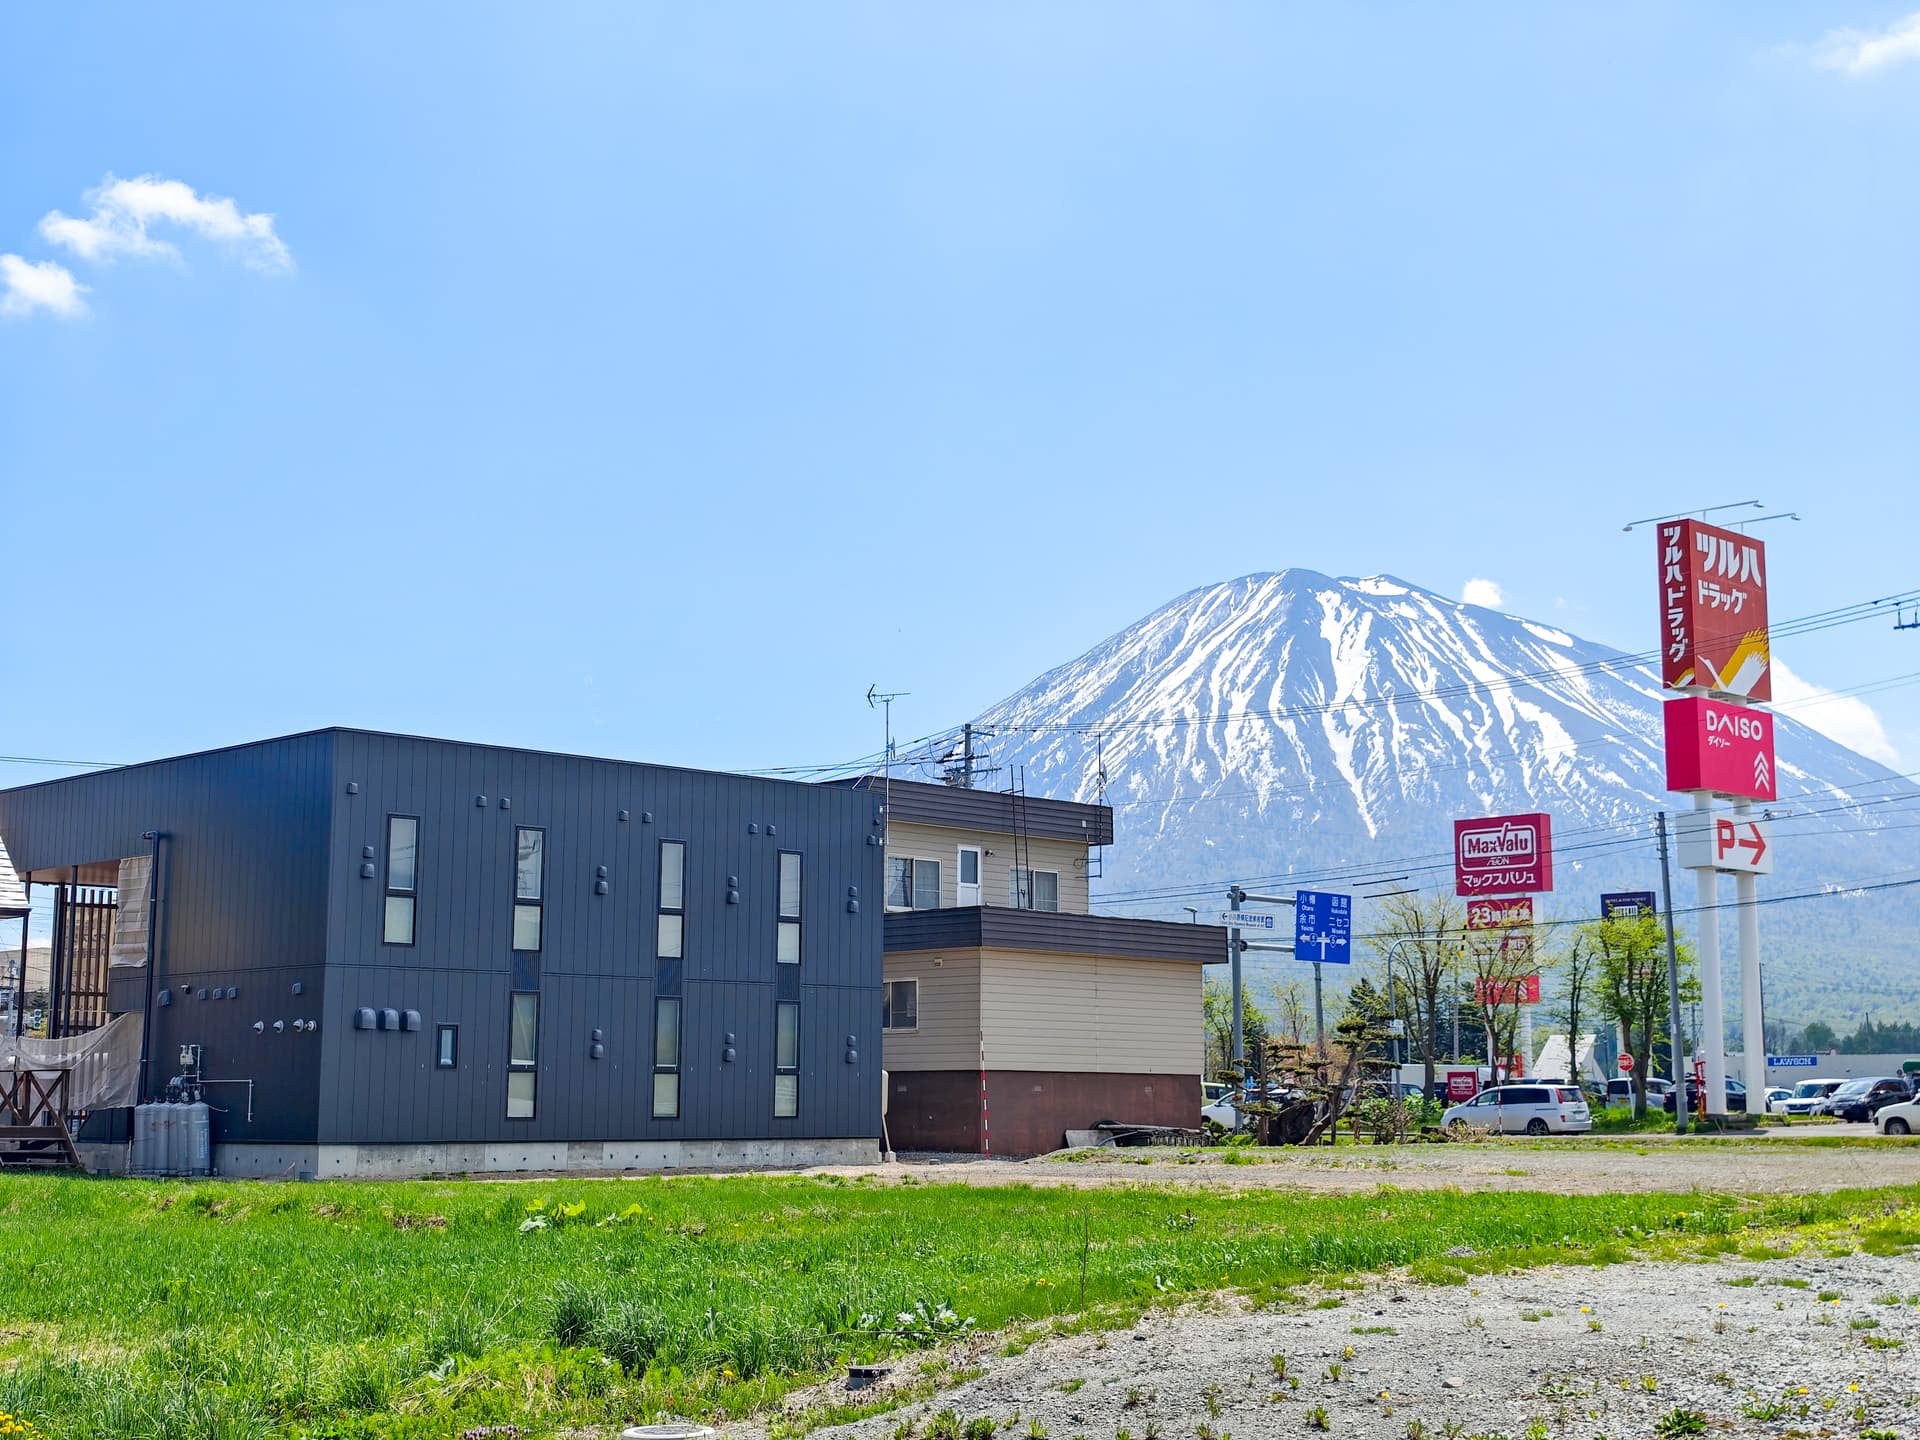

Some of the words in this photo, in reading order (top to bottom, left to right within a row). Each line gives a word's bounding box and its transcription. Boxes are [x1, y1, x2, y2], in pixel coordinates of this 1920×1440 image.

[1696, 531, 1762, 588] ツルハ
[1663, 525, 1688, 663] ツルハドラッグ
[1697, 580, 1747, 614] ドラッグ
[1706, 709, 1763, 741] DAISO
[1707, 735, 1731, 748] ダイソー
[1468, 823, 1529, 855] MaxValu
[1716, 818, 1735, 860] P
[1462, 871, 1536, 888] マックスバリュ
[1299, 913, 1316, 925] 余市
[1328, 917, 1350, 928] ニセコ
[1773, 1057, 1811, 1066] LAWSON
